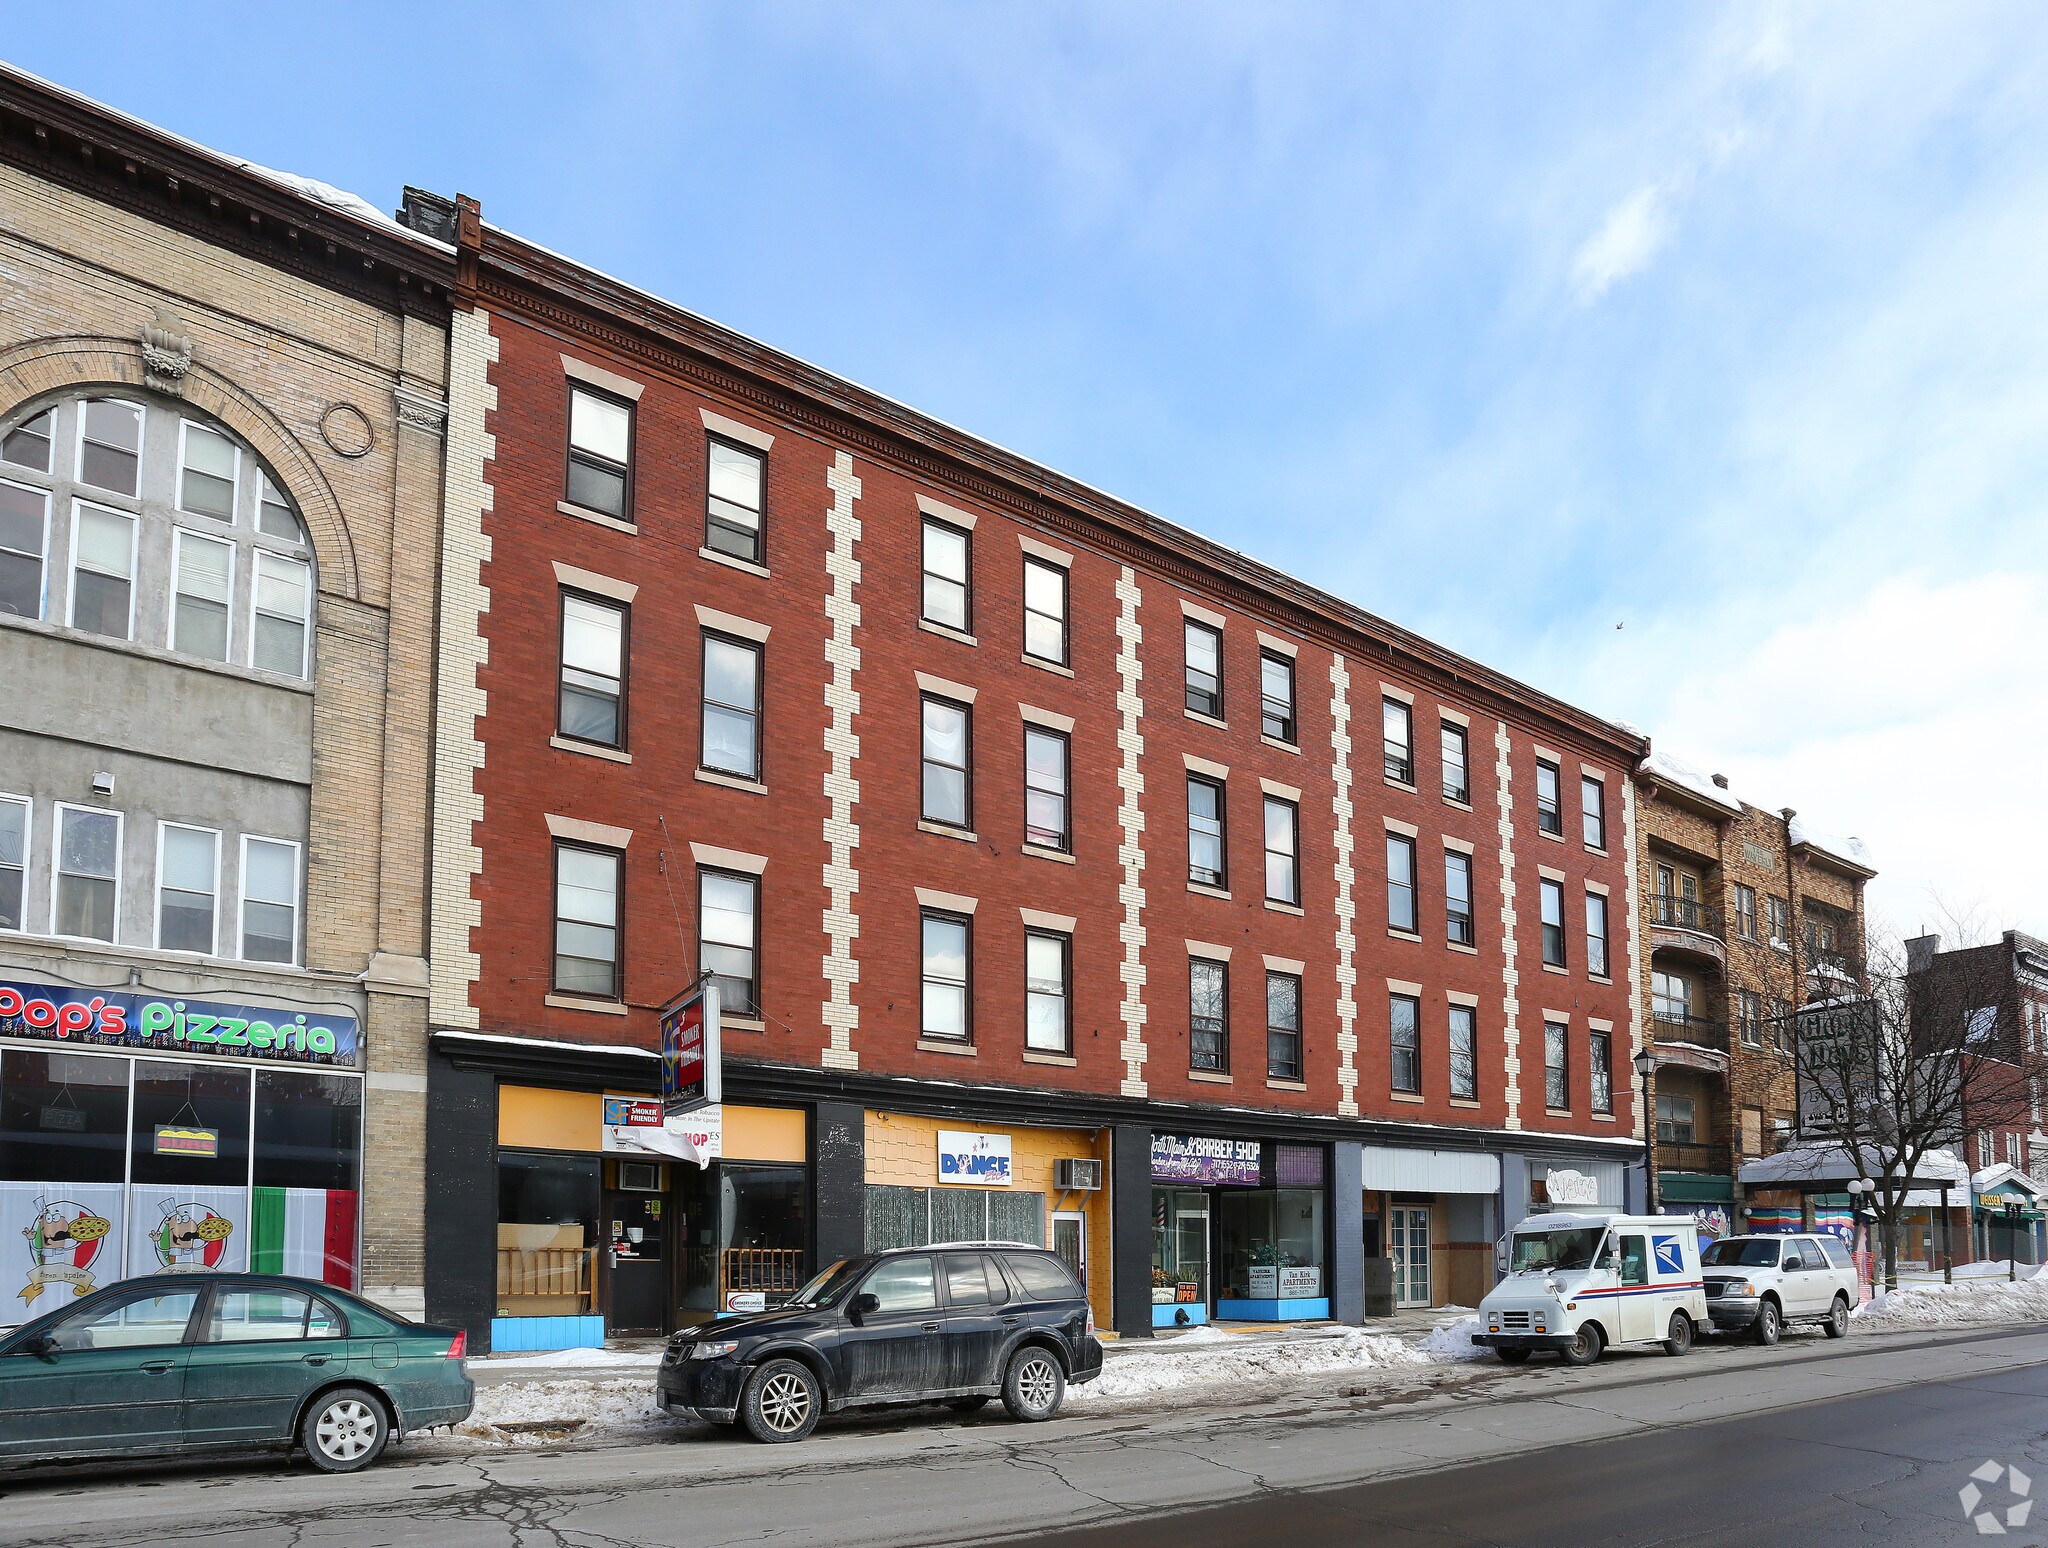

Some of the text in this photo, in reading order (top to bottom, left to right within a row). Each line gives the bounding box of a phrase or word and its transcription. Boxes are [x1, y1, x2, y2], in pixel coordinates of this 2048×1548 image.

[1744, 849, 1772, 868] WAVERLY
[0, 987, 337, 1055] Pop's Pizzeria
[680, 1023, 700, 1047] SMOKER
[1809, 1086, 1849, 1103] FOO
[630, 1115, 658, 1123] FRIENDLY
[631, 1107, 657, 1115] SMOKER
[157, 1137, 215, 1151] SUBS
[1196, 1138, 1233, 1159] BARBER
[1236, 1142, 1260, 1161] SHOP
[941, 1153, 1010, 1176] DANCE
[1282, 1278, 1317, 1287] APARTMENTS
[1178, 1290, 1196, 1302] OPEN
